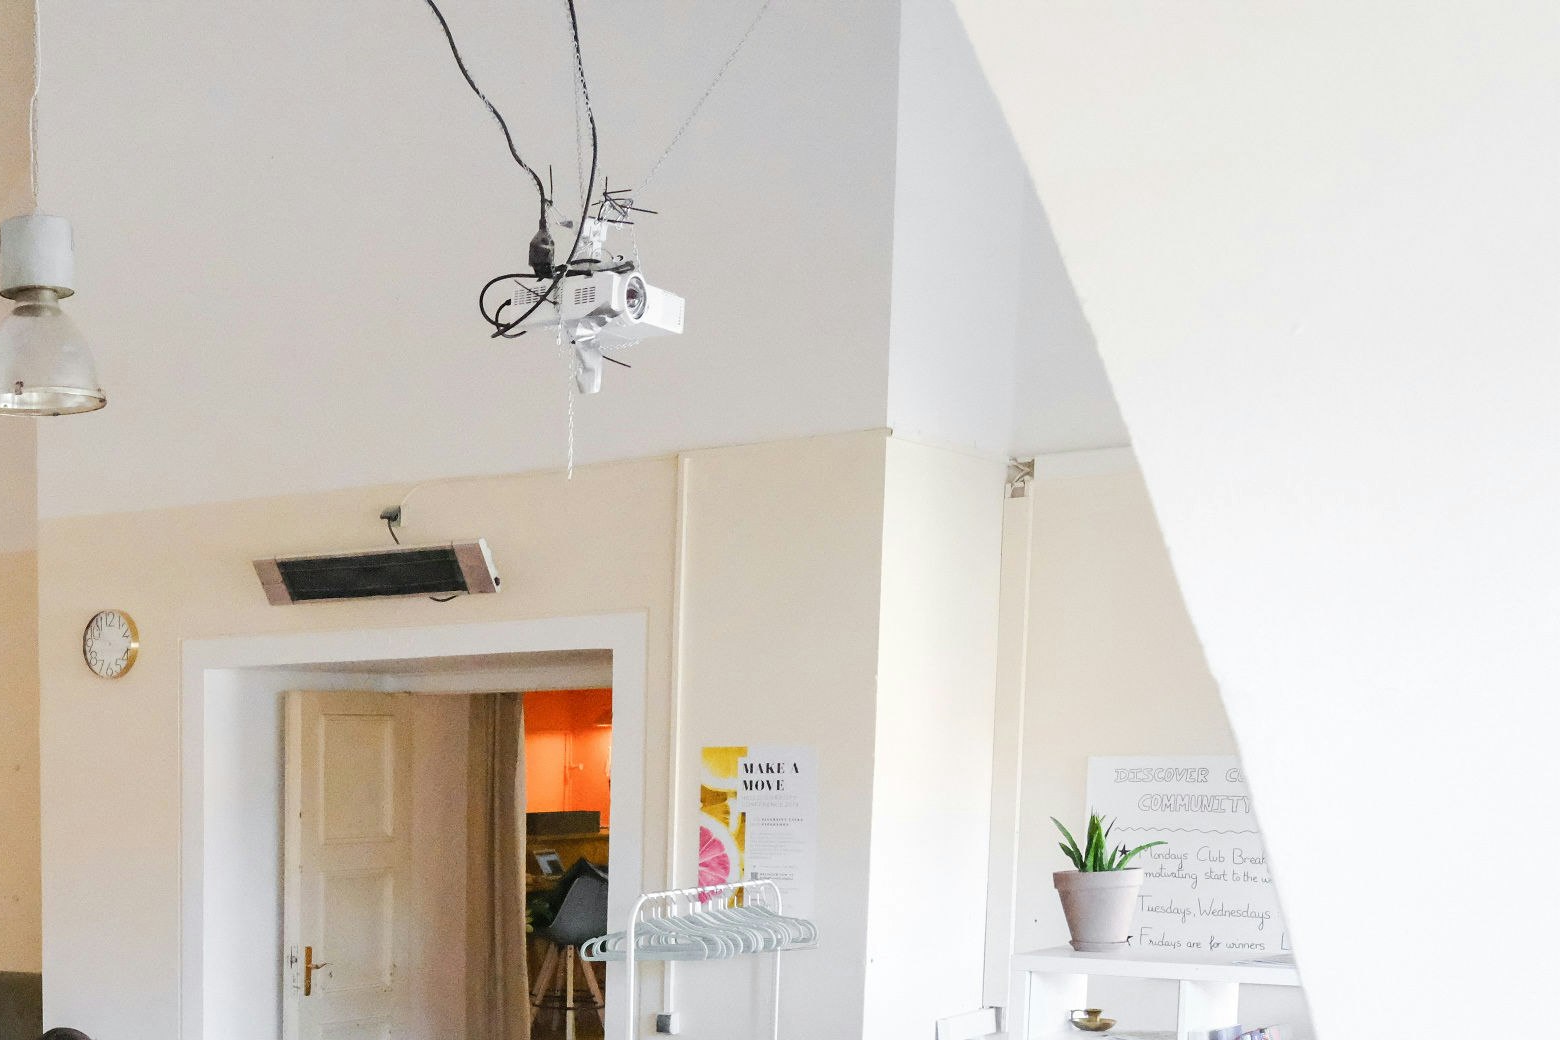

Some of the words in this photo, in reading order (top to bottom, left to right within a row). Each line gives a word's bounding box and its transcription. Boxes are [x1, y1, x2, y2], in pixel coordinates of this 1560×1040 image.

[105, 611, 115, 627] 12
[89, 650, 98, 666] 8
[105, 662, 114, 678] 6
[743, 762, 785, 774] MAKE
[792, 762, 800, 774] A
[1113, 767, 1211, 784] DISCOVER
[743, 779, 785, 791] MOVE
[1137, 793, 1251, 814] COMMUNITY
[1138, 846, 1189, 870] Mondays
[1196, 845, 1226, 863] Club
[1144, 865, 1198, 889] motivating
[1204, 868, 1228, 882] start
[1137, 895, 1197, 924] Tuesdays,
[1197, 897, 1272, 931] Wednesdays
[1139, 926, 1182, 951] Fridays
[1186, 937, 1202, 949] are
[1209, 935, 1222, 952] for
[1225, 937, 1267, 951] winners
